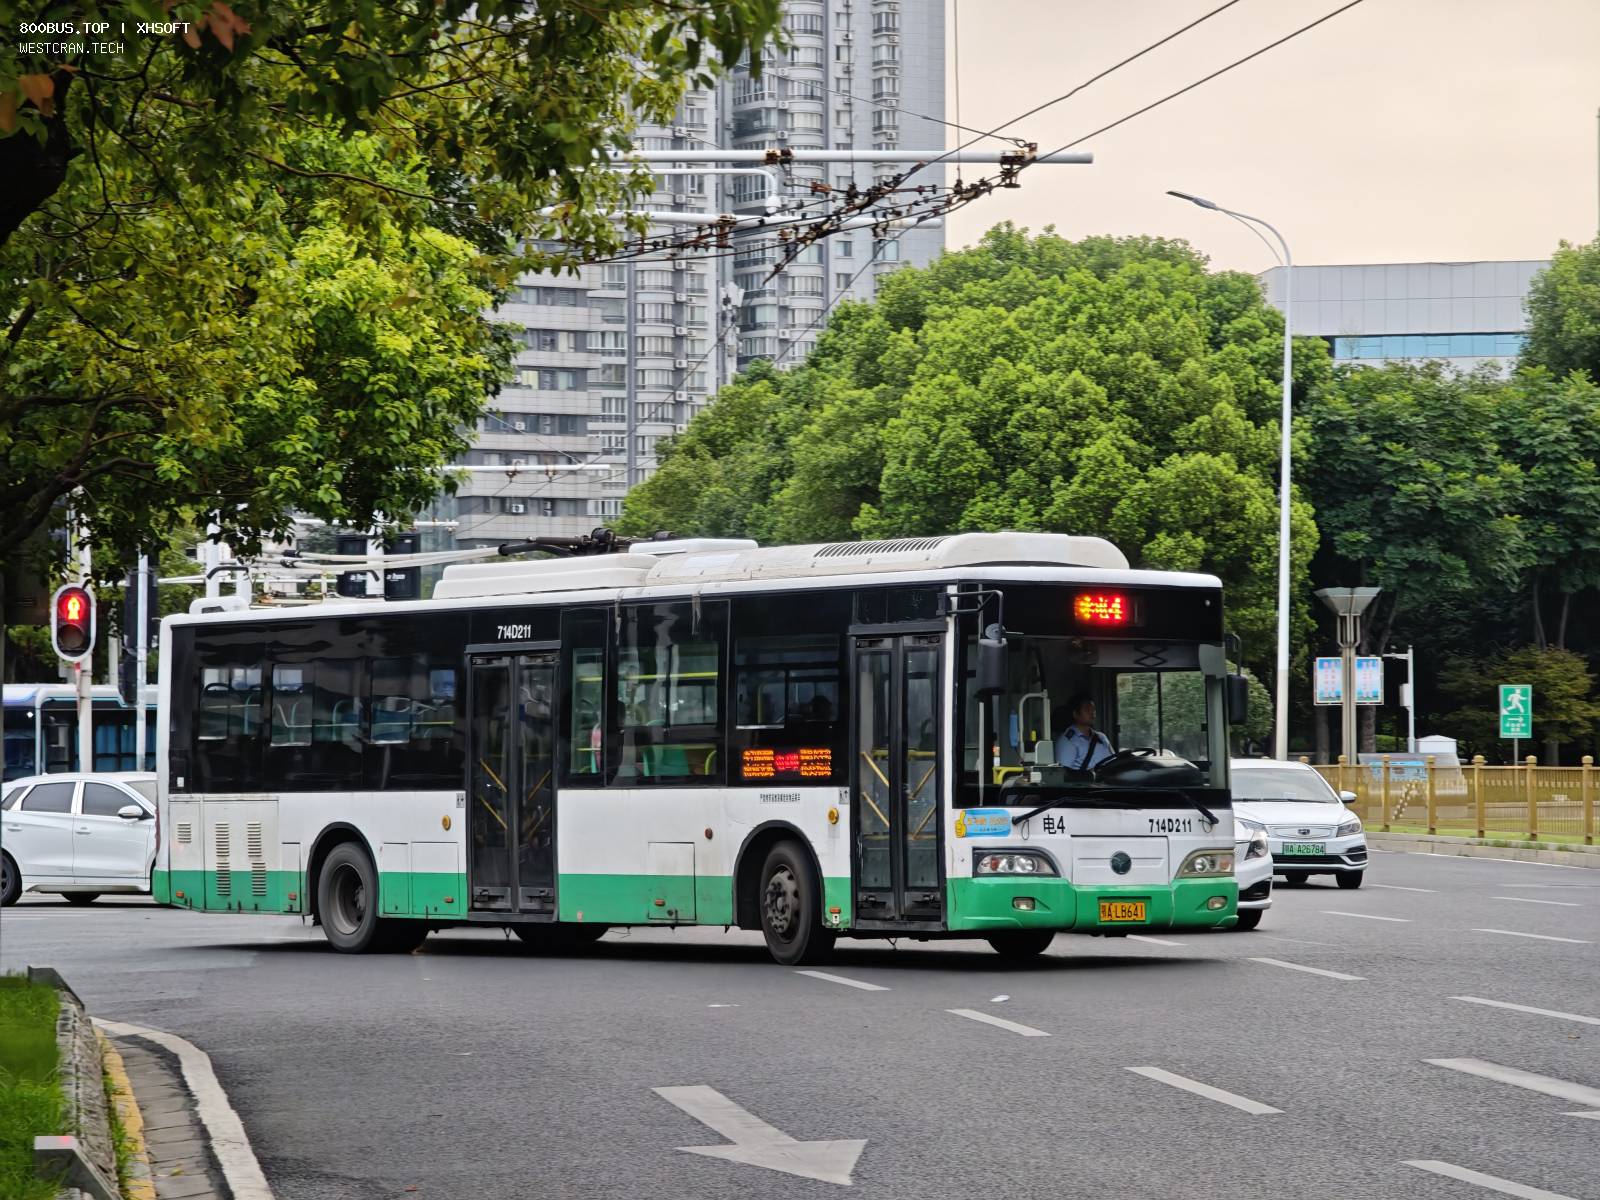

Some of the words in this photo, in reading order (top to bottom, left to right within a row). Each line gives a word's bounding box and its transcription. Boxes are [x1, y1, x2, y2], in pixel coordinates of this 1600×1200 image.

[497, 624, 531, 640] 714D211
[1043, 814, 1065, 834] 电4
[1148, 818, 1192, 833] 714D211
